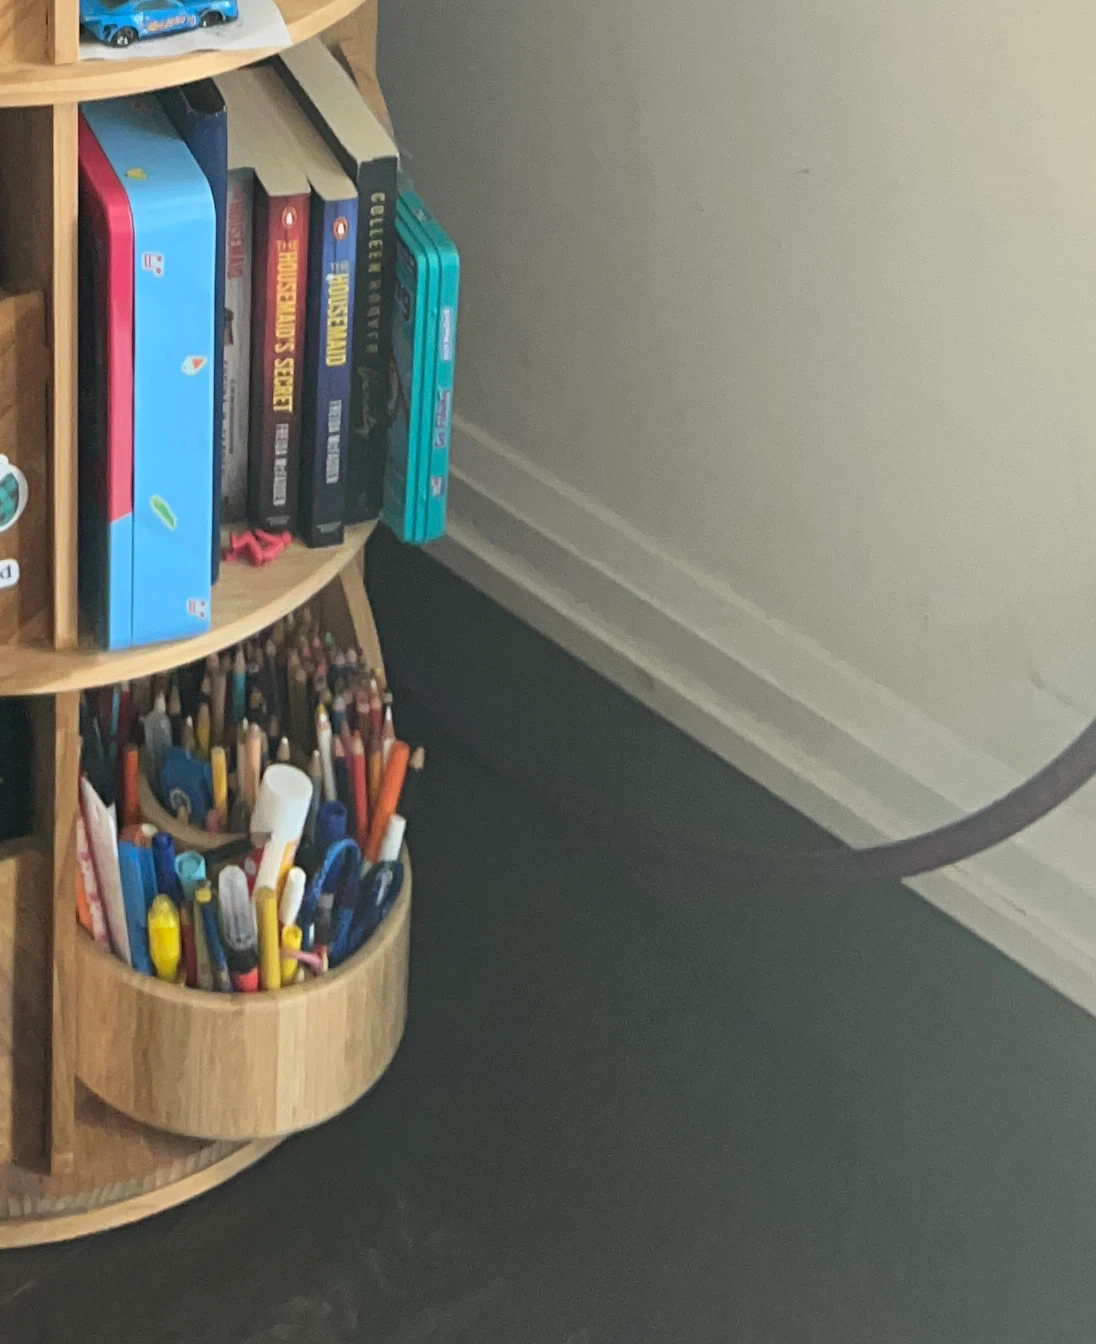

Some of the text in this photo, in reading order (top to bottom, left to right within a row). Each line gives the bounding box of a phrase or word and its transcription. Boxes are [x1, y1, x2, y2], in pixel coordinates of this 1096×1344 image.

[369, 192, 385, 273] COLLEEN
[271, 251, 299, 413] HOUSEMAID'S SECRET
[325, 271, 349, 367] HOUSEMAID
